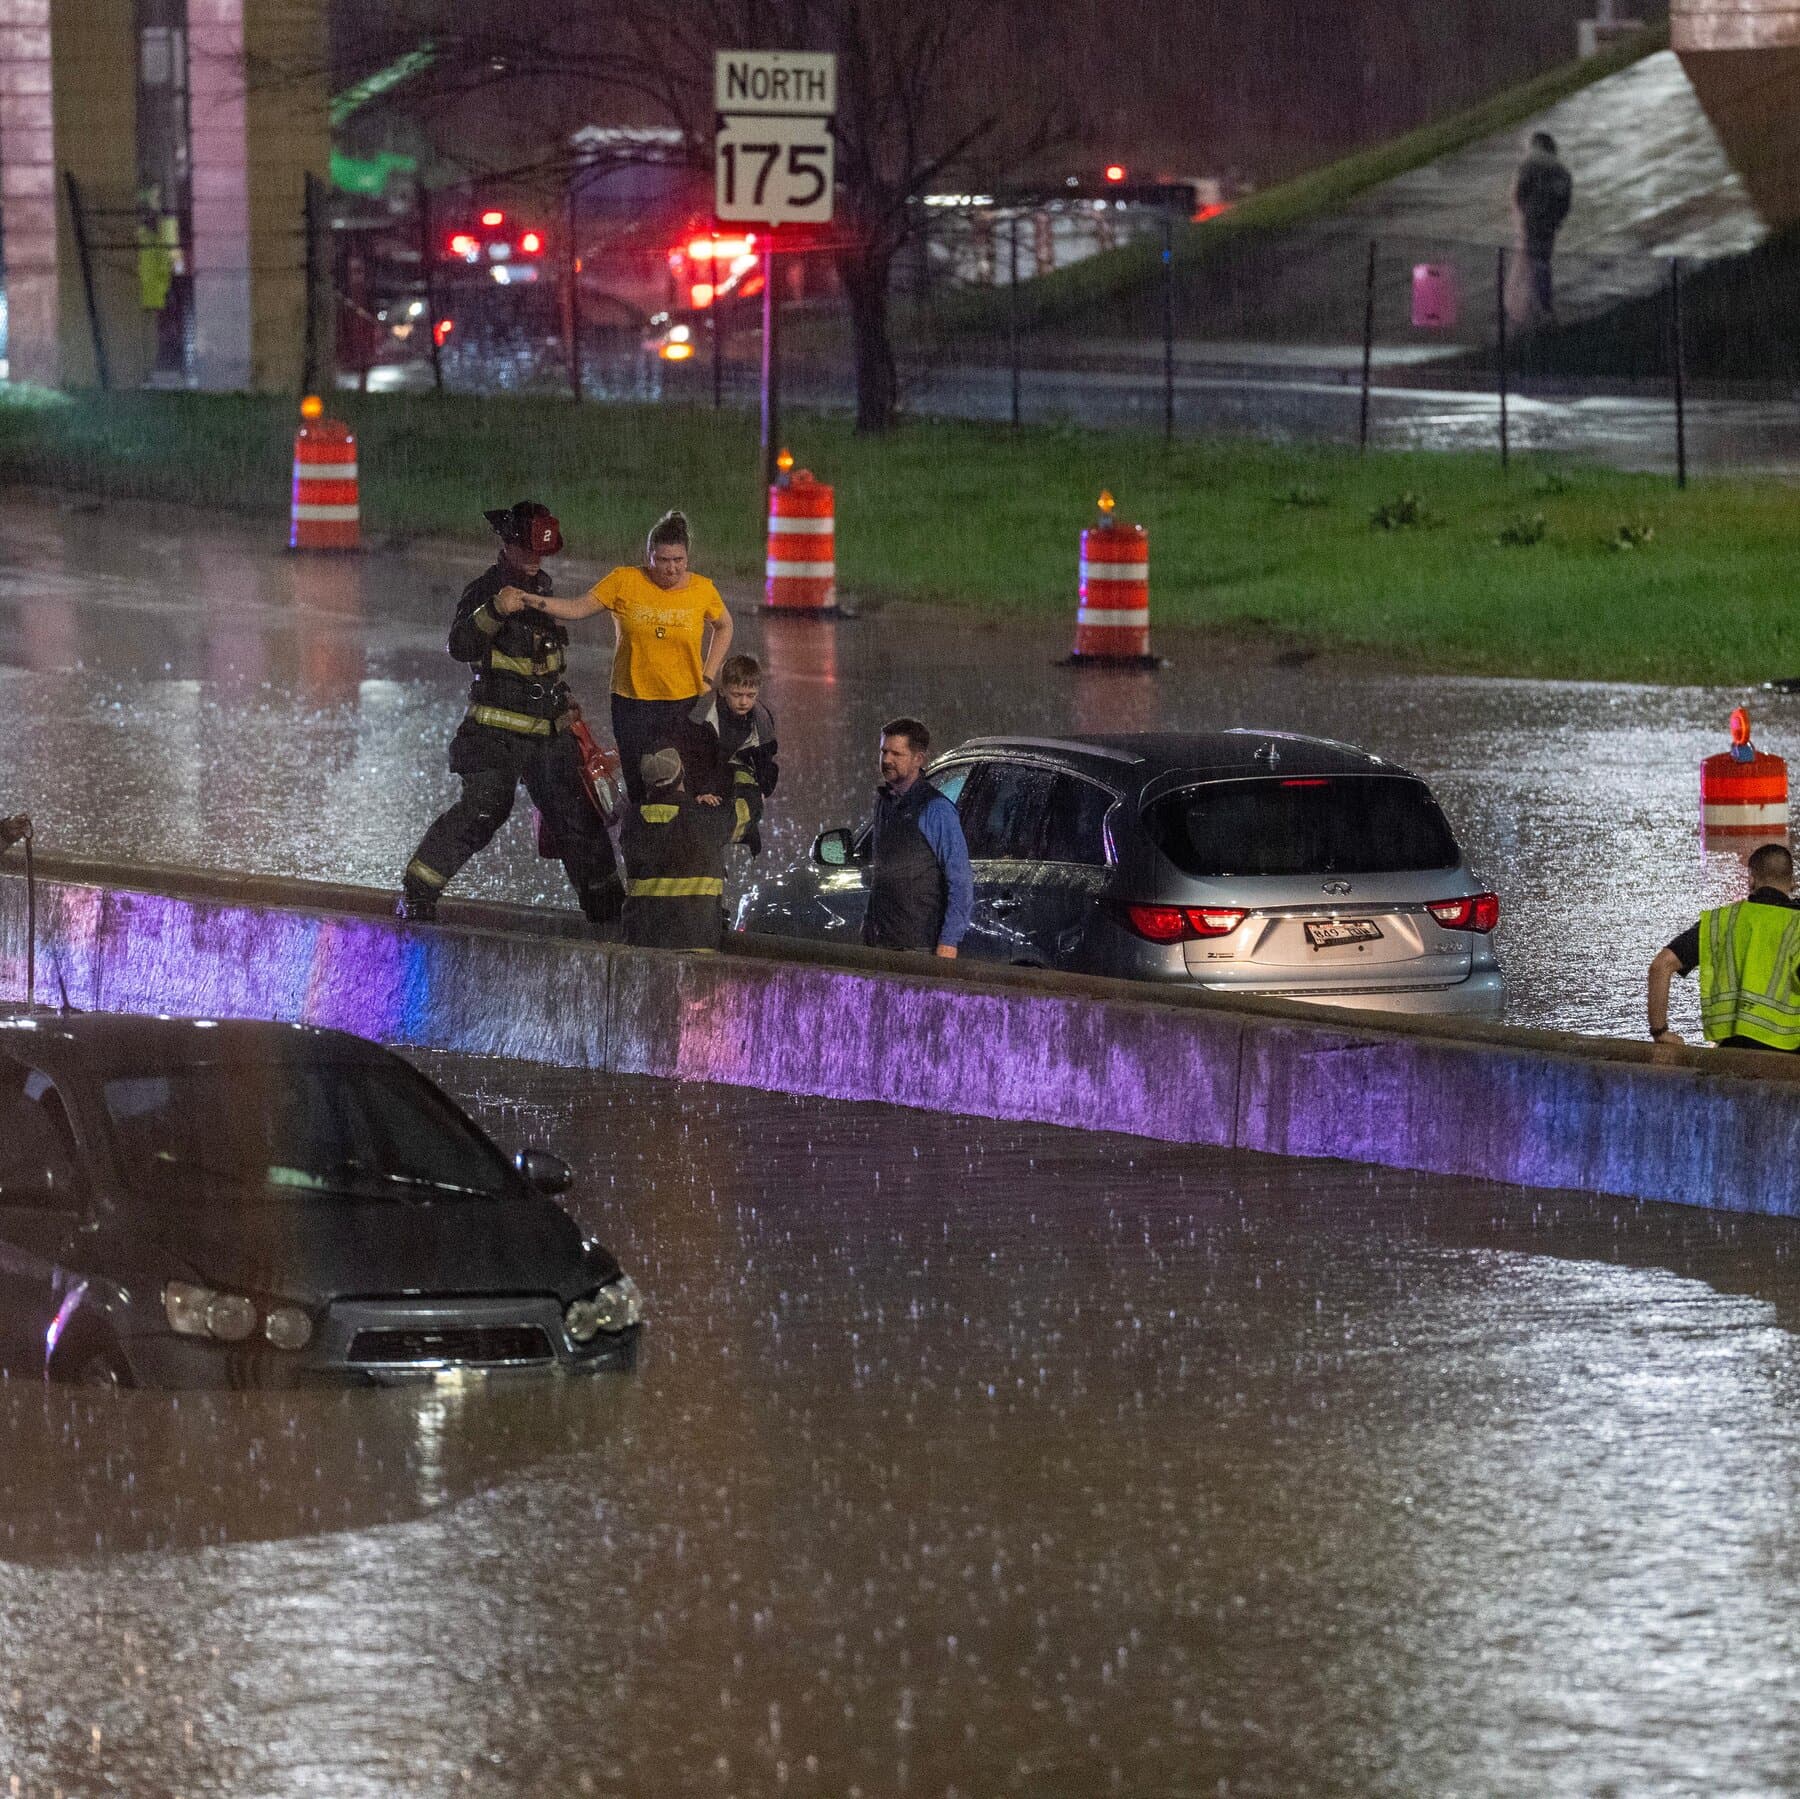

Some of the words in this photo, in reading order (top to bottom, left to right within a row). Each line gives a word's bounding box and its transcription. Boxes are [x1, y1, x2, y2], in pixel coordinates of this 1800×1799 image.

[727, 62, 826, 100] NORTH
[721, 143, 827, 207] 175
[543, 529, 552, 542] 2
